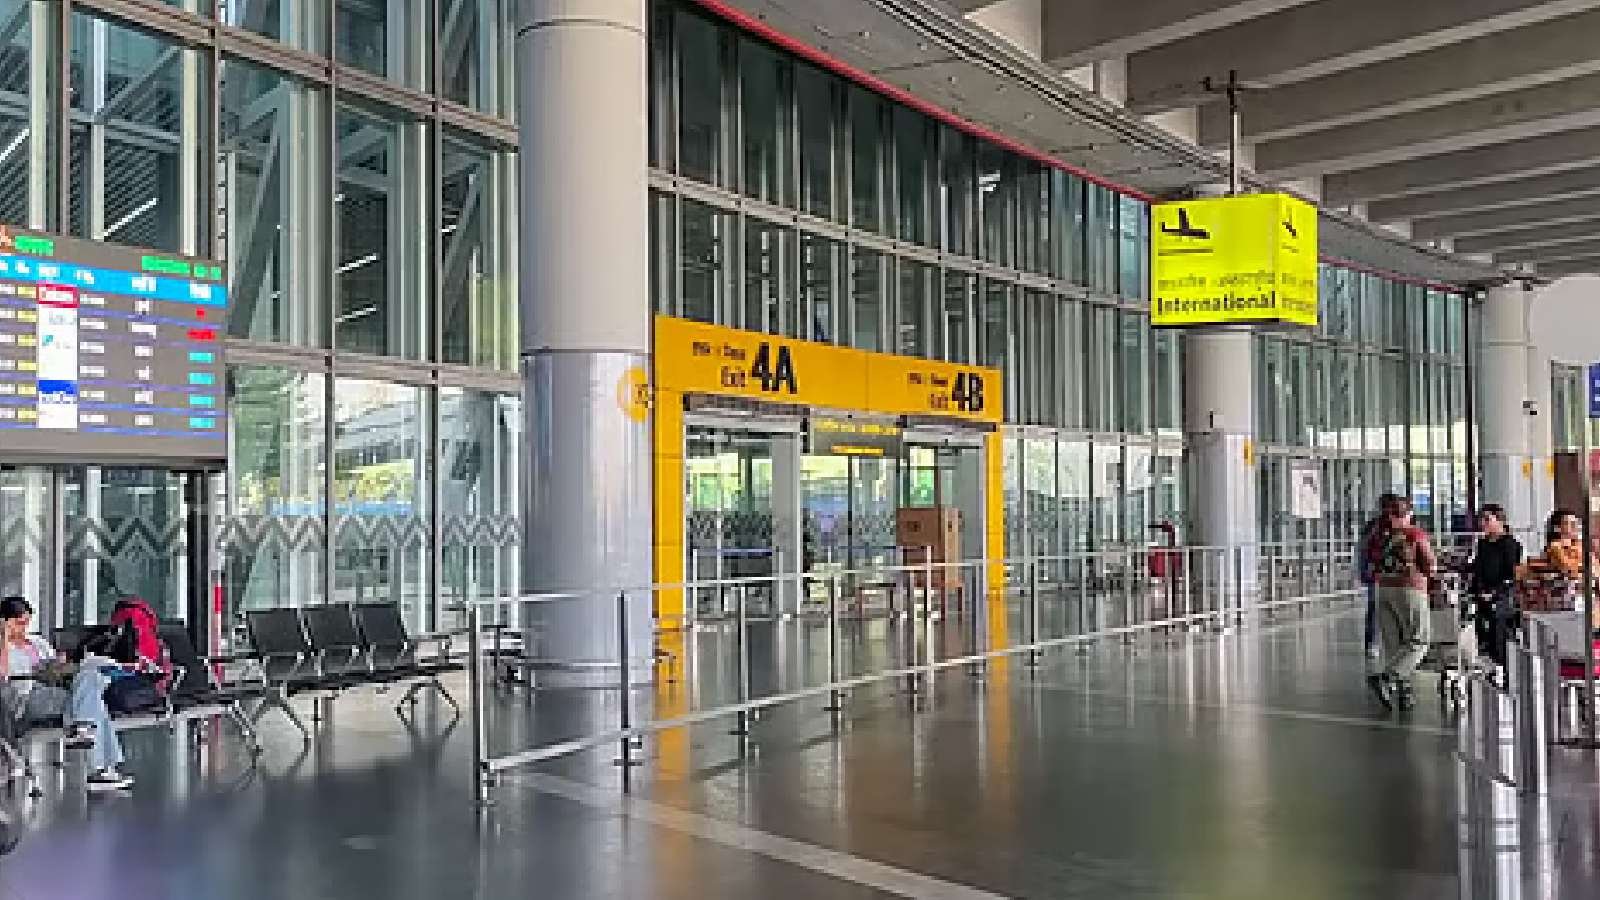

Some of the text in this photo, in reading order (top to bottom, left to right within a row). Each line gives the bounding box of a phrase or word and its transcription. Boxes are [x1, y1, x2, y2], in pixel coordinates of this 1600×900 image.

[1157, 291, 1276, 316] International
[751, 341, 798, 395] 4A
[951, 372, 984, 412] 4B
